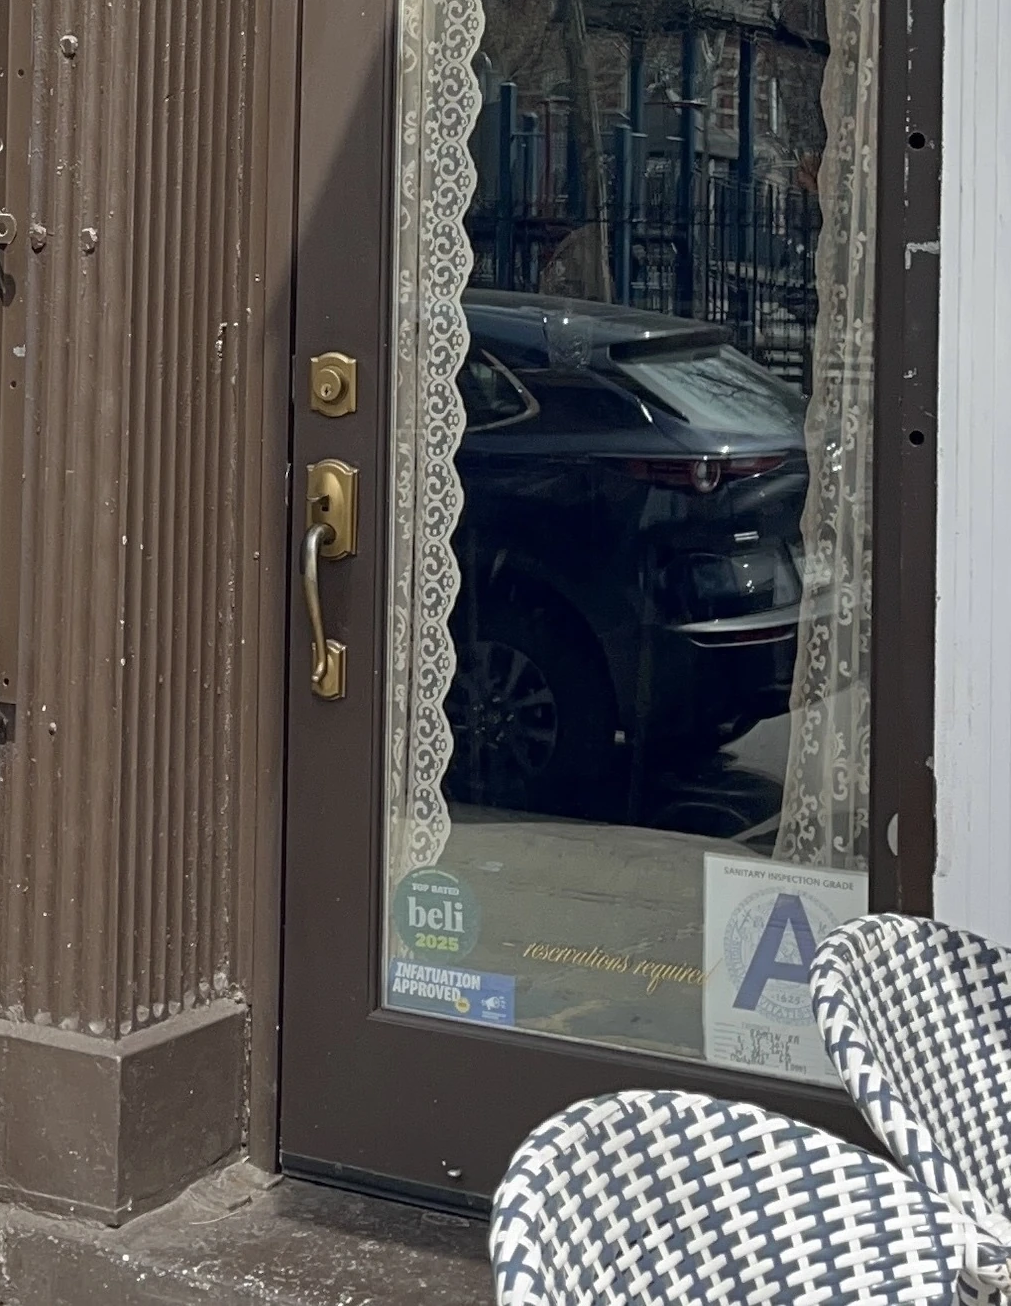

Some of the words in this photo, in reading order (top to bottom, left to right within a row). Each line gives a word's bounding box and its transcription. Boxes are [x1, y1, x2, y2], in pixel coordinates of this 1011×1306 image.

[723, 866, 766, 878] SANITARY
[768, 872, 820, 887] INSPECTION
[822, 879, 854, 891] GRADE
[407, 896, 465, 934] beli
[414, 932, 460, 953] 2025
[732, 892, 817, 1011] A
[523, 942, 631, 974] reservations
[392, 977, 461, 1003] APPROVED
[394, 961, 481, 991] INFATUATION
